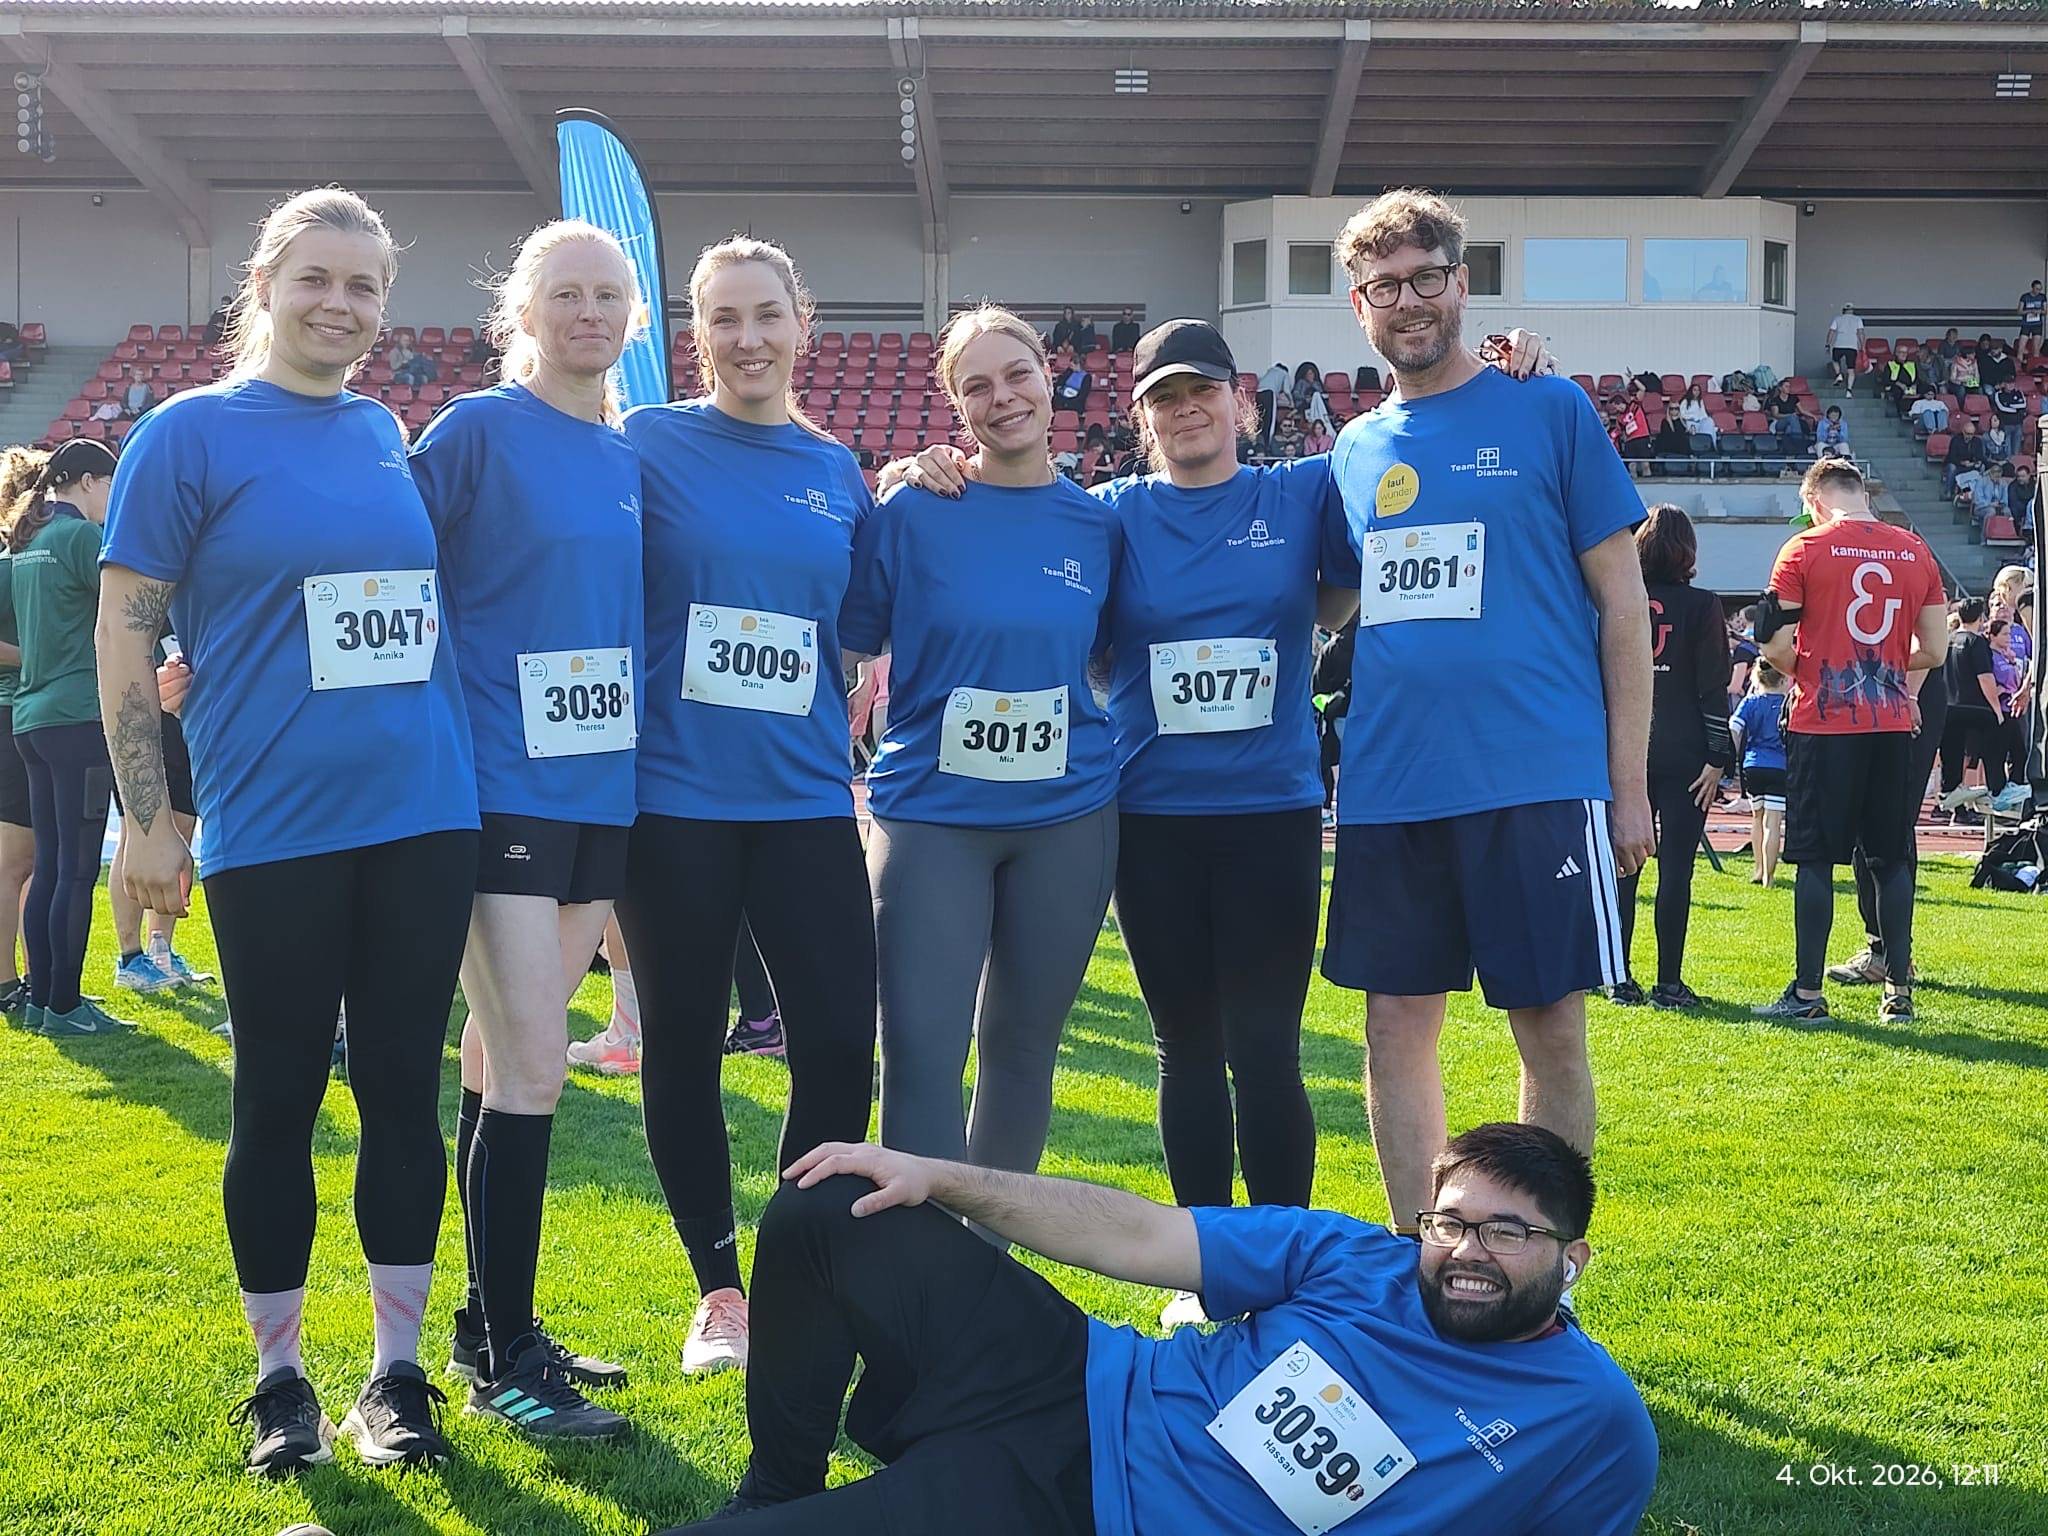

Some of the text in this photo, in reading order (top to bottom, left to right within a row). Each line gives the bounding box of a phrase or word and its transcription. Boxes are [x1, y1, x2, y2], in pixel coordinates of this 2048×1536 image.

[1450, 463, 1476, 472] Team
[1476, 468, 1519, 477] Diakonie
[1387, 475, 1406, 489] lauf
[783, 494, 809, 505] Team
[1380, 487, 1413, 503] wunder
[1830, 545, 1916, 562] kammann.de
[1042, 567, 1065, 578] Team
[1379, 555, 1459, 593] 3061
[1399, 592, 1435, 601] Thorsten
[335, 608, 424, 651] 3047
[373, 651, 405, 661] Annika
[707, 639, 800, 683] 3009
[741, 679, 764, 690] Dana
[1171, 667, 1260, 704] 3077
[544, 682, 622, 722] 3038
[1200, 703, 1235, 713] Nathalie
[575, 723, 605, 732] Theresa
[962, 719, 1052, 753] 3013
[999, 755, 1015, 763] Mia
[1454, 1406, 1479, 1433] Team
[1254, 1386, 1361, 1496] 3039
[1263, 1438, 1296, 1477] Hassan
